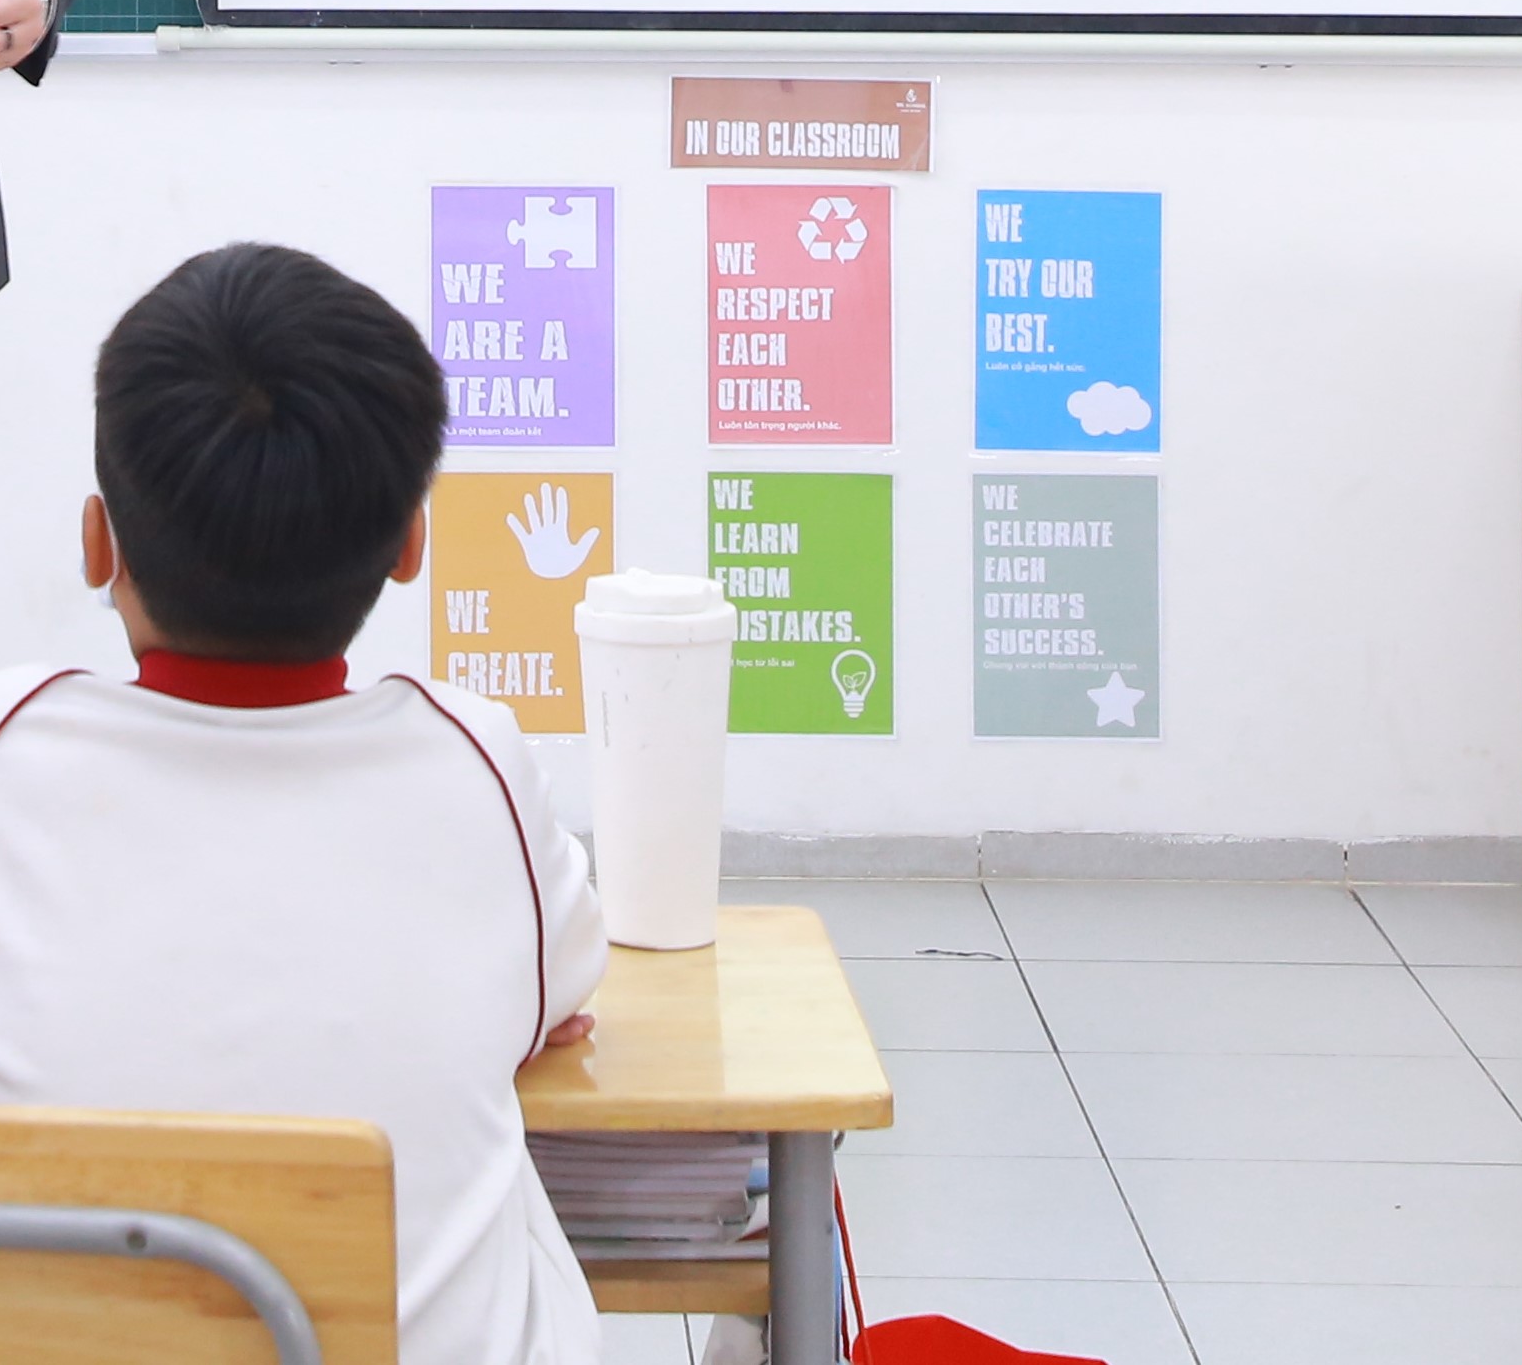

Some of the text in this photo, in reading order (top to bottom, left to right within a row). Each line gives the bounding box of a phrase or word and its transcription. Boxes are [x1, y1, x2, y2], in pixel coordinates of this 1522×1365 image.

[685, 120, 900, 160] IN OUR CLASSROOM
[985, 203, 1023, 243] WE
[715, 242, 756, 275] WE
[440, 263, 506, 304] WE
[985, 258, 1094, 299] TRY OUR
[716, 287, 834, 321] RESPECT
[442, 319, 569, 361] ARE A
[717, 332, 786, 366] EACH
[985, 313, 1055, 353] BEST.
[444, 376, 570, 418] TEAM.
[718, 378, 811, 412] OTHER.
[712, 479, 754, 511] WE
[982, 485, 1018, 511] WE
[714, 523, 799, 554] LEARN
[984, 521, 1113, 547] CELEBRATE
[714, 566, 791, 598] FROM
[984, 557, 1046, 583] EACH
[445, 590, 490, 634] WE
[984, 593, 1085, 619] OTHER'S
[734, 610, 861, 643] ISTAKES.
[984, 629, 1104, 656] SUCCESS.
[447, 652, 564, 697] CREATE.
